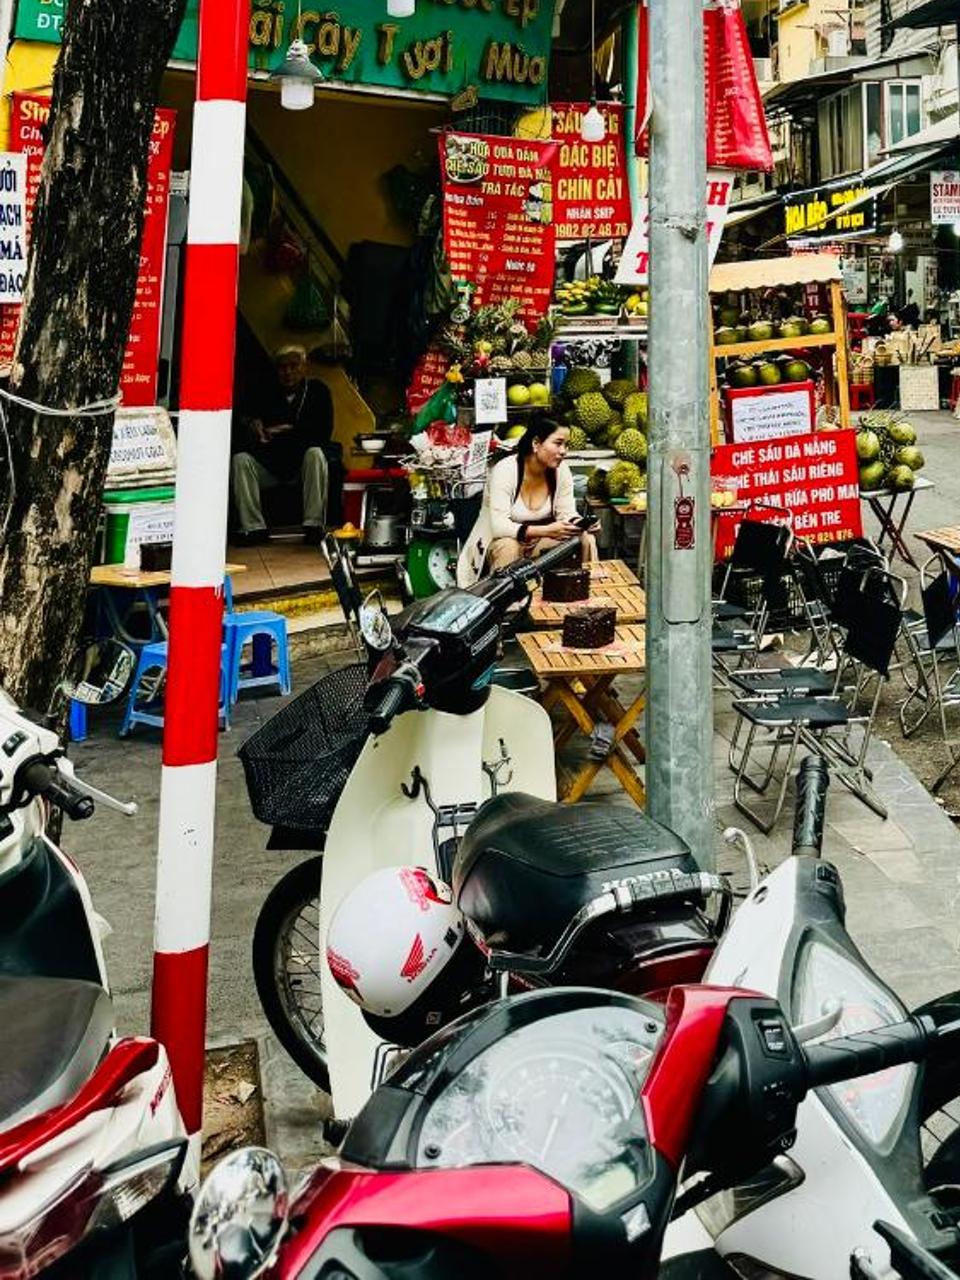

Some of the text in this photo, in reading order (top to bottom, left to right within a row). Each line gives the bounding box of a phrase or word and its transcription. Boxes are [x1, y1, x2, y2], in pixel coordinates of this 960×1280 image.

[20, 100, 50, 125] Sin
[559, 141, 590, 172] ĐẶC
[557, 172, 623, 201] CHÍN CÂY
[593, 207, 616, 220] SHIP
[732, 448, 755, 467] CHÈ
[784, 441, 802, 459] ĐÀ
[753, 470, 780, 488] THÁI
[809, 461, 844, 480] RIÊNG
[821, 510, 842, 525] TRE
